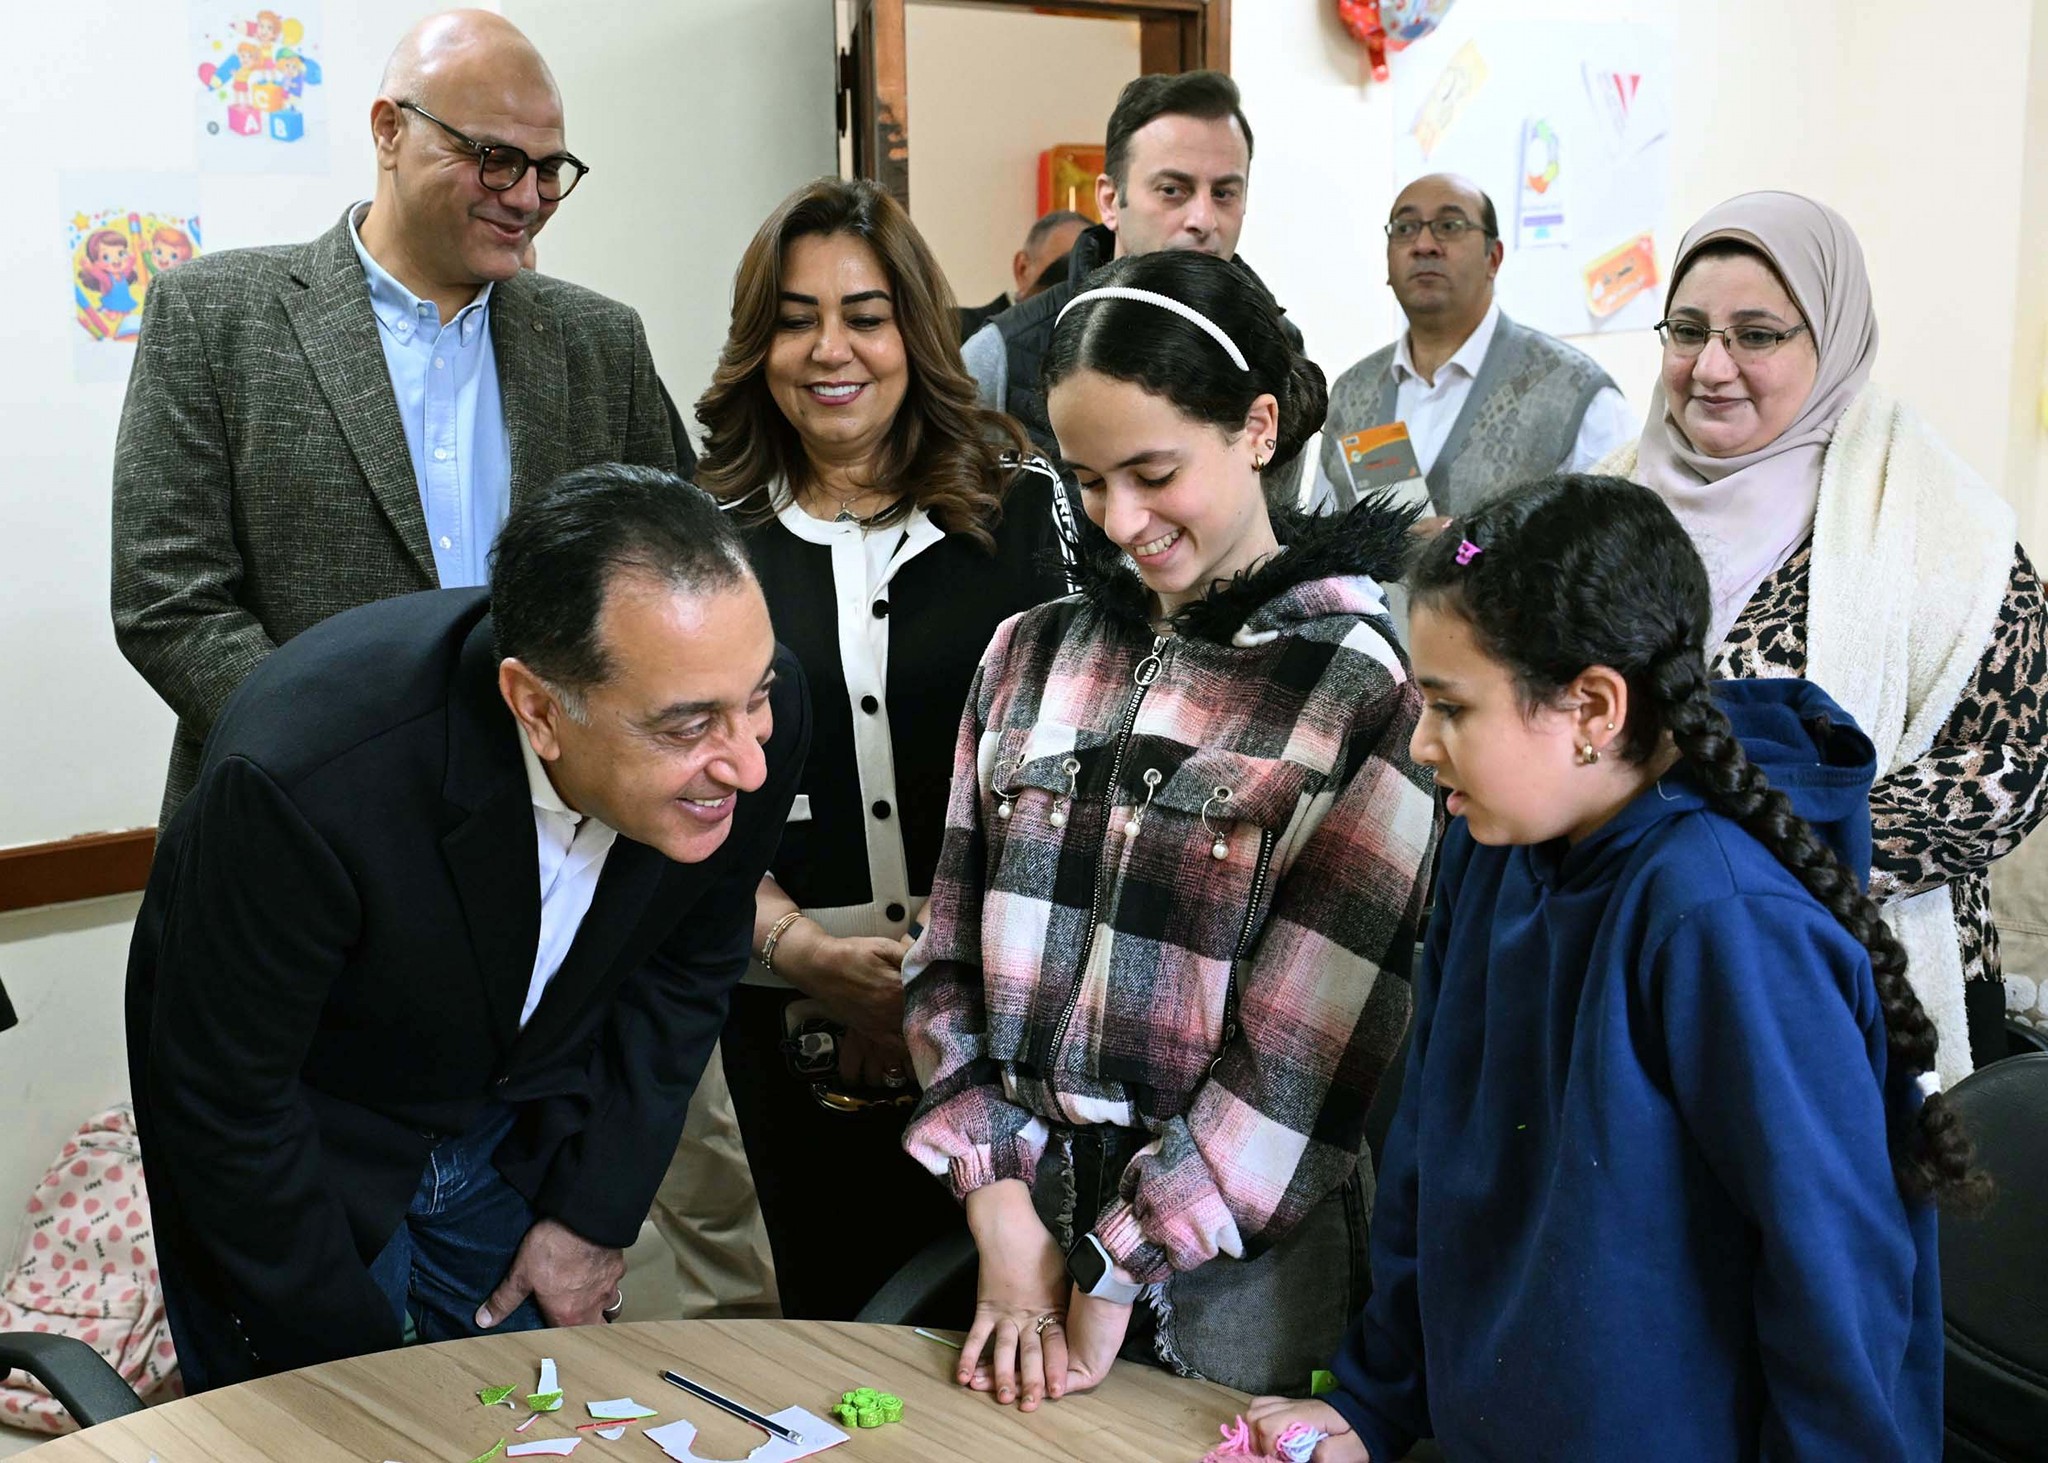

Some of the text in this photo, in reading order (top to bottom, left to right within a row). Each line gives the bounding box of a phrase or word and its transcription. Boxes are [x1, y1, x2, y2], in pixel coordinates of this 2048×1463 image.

[255, 90, 269, 109] C
[244, 114, 259, 133] A
[274, 117, 287, 137] B
